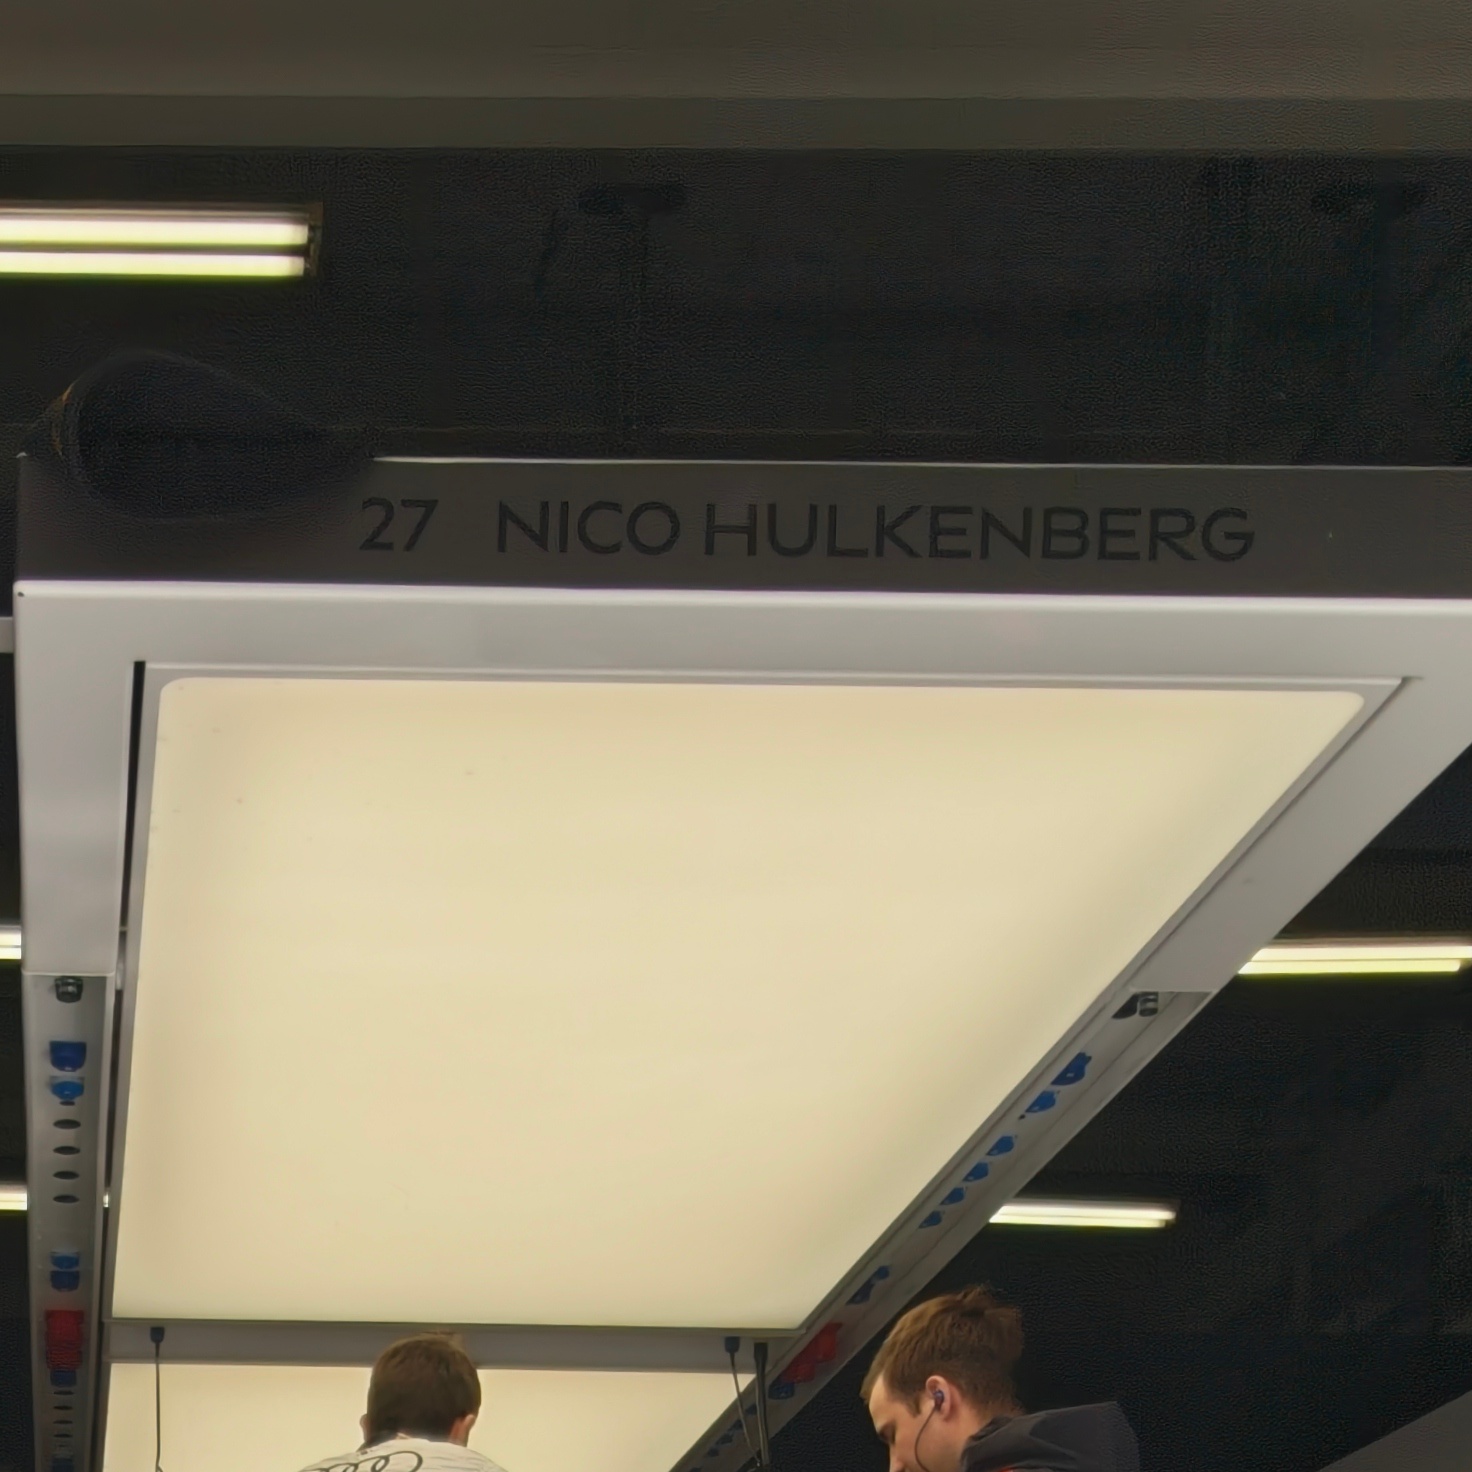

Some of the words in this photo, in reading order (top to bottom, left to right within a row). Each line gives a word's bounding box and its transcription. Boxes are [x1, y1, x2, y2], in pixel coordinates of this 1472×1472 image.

[358, 496, 441, 553] 27
[496, 499, 682, 556] NICO
[703, 502, 1257, 563] HULKENBERG
